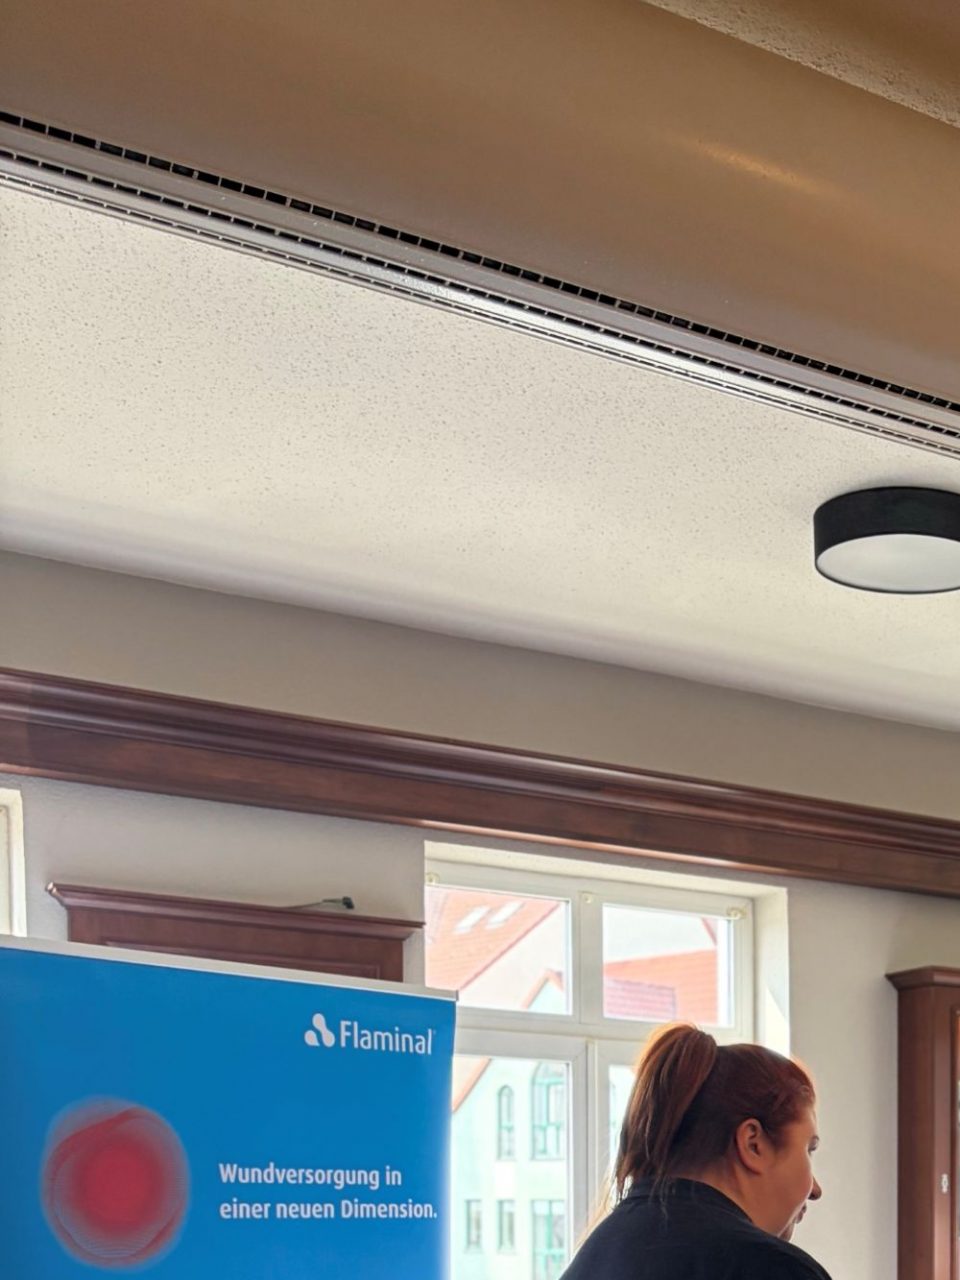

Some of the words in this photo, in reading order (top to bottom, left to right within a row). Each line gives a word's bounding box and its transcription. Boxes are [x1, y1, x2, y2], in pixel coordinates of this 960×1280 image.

[340, 1020, 432, 1055] Flaminal
[219, 1161, 380, 1190] Wundversorgung
[385, 1165, 402, 1186] in
[219, 1198, 271, 1219] einer
[275, 1202, 335, 1219] neuen
[341, 1198, 438, 1219] Dimension.
